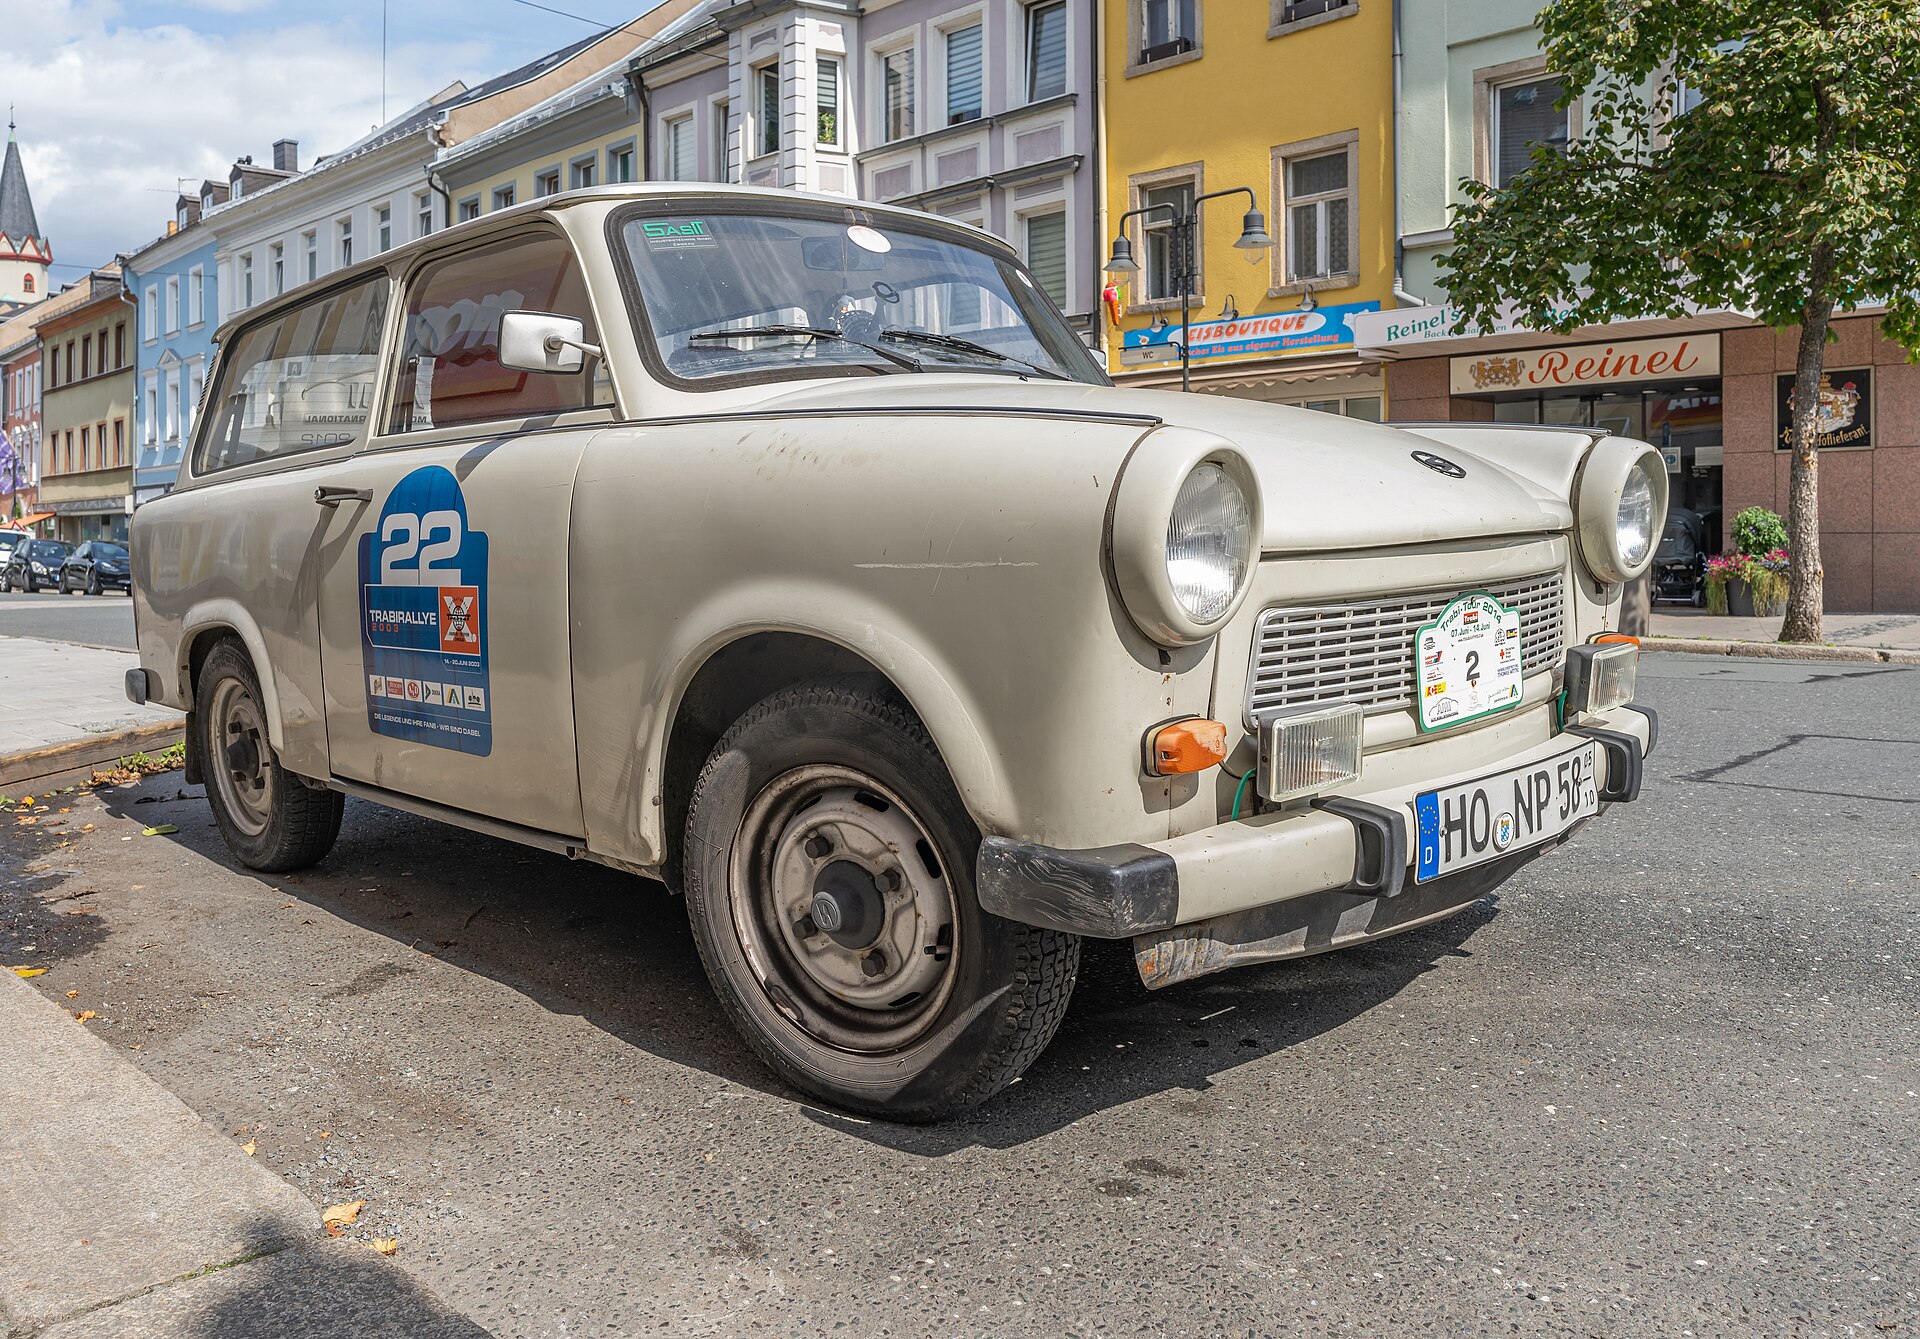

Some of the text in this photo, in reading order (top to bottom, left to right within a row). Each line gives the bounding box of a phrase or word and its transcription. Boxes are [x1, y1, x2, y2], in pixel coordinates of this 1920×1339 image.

[1188, 313, 1308, 343] EISBOUTIQUE
[1387, 307, 1461, 342] Reinel's
[1211, 345, 1225, 354] Eis
[1228, 344, 1243, 352] aus
[1282, 333, 1339, 347] Herstellung
[1142, 351, 1154, 359] WC
[1528, 342, 1698, 384] Reinel
[381, 510, 462, 585] 22
[369, 610, 437, 625] TRABIRALLYE
[1482, 601, 1502, 624] 2014
[371, 622, 399, 632] 2003
[1465, 650, 1480, 681] 2
[374, 712, 382, 720] DIE
[381, 713, 402, 724] LEGENDE
[401, 717, 412, 725] UND
[412, 718, 423, 727] IHRE
[423, 720, 436, 730] FANS
[439, 723, 450, 731] WIR
[449, 725, 462, 734] SIND
[1583, 750, 1592, 769] 05
[1444, 756, 1581, 863] HO NP 58
[1584, 789, 1595, 808] 10
[1424, 846, 1433, 865] D
